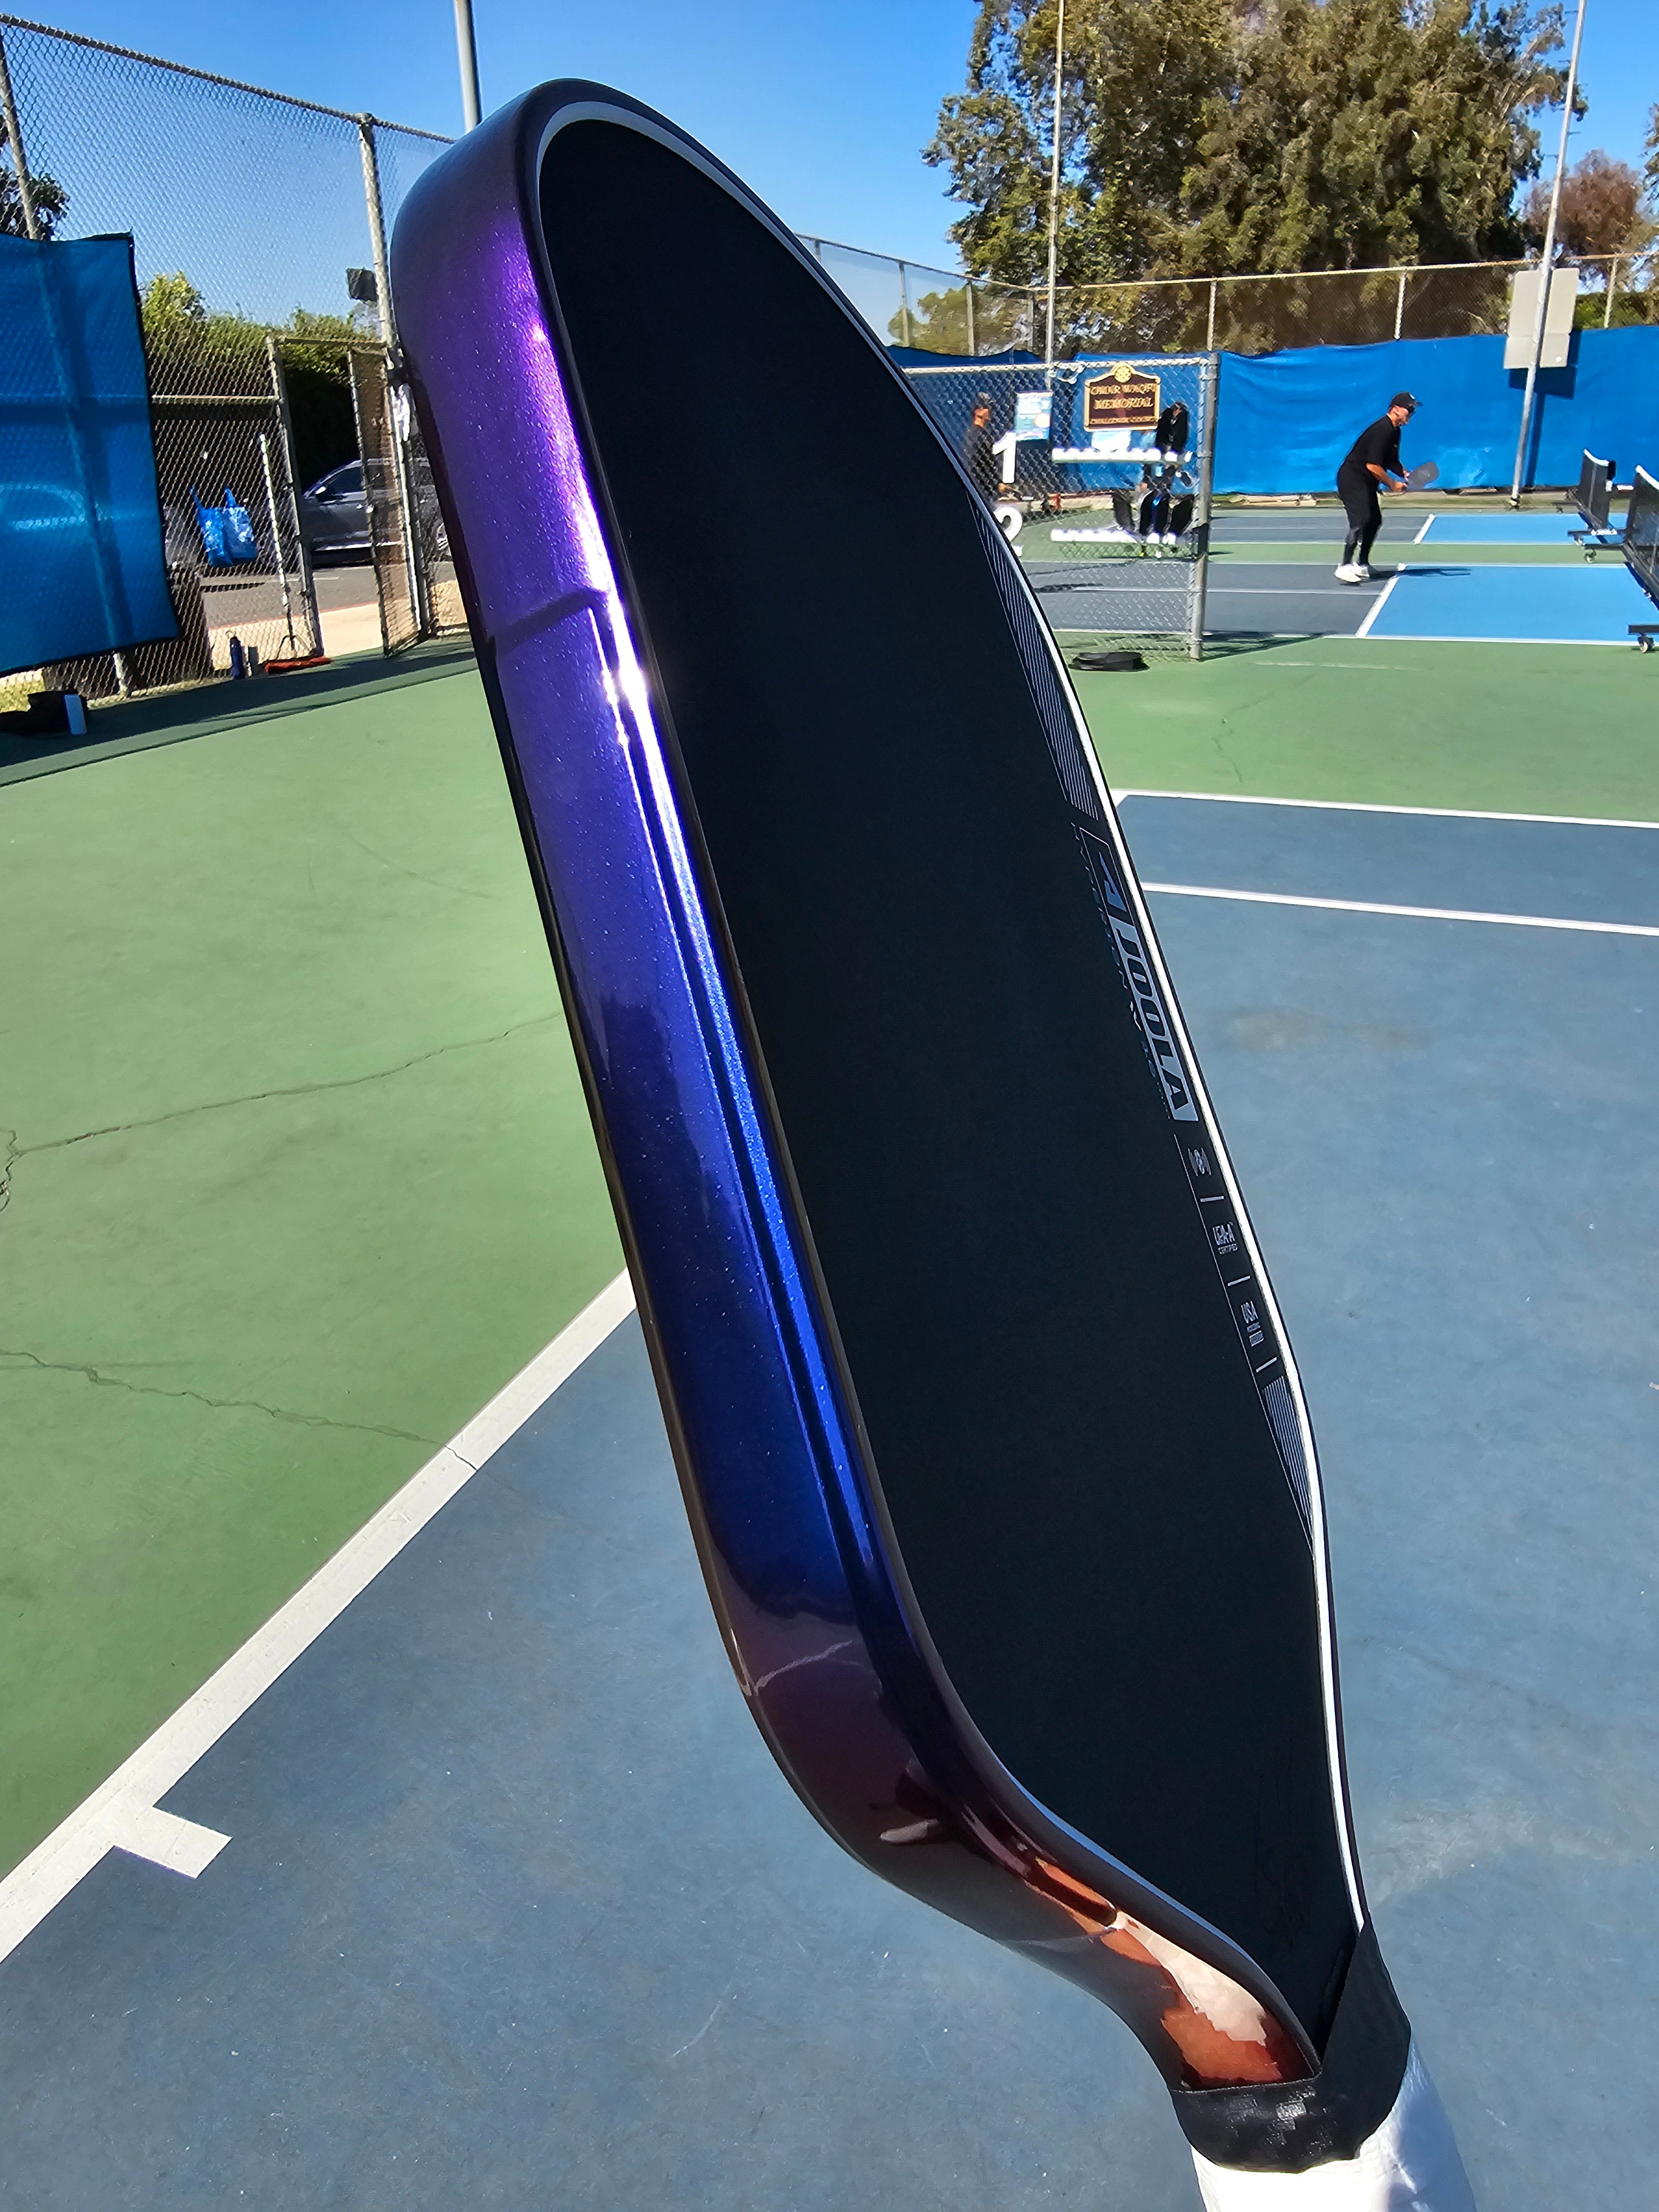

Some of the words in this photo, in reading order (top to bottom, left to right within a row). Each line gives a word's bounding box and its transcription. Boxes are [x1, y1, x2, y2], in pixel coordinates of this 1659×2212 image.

[1093, 398, 1154, 409] MEMORIAL
[992, 432, 1016, 483] 1
[994, 506, 1022, 557] 2
[1071, 821, 1129, 990] HYPERION
[1116, 929, 1189, 1110] JOOLA
